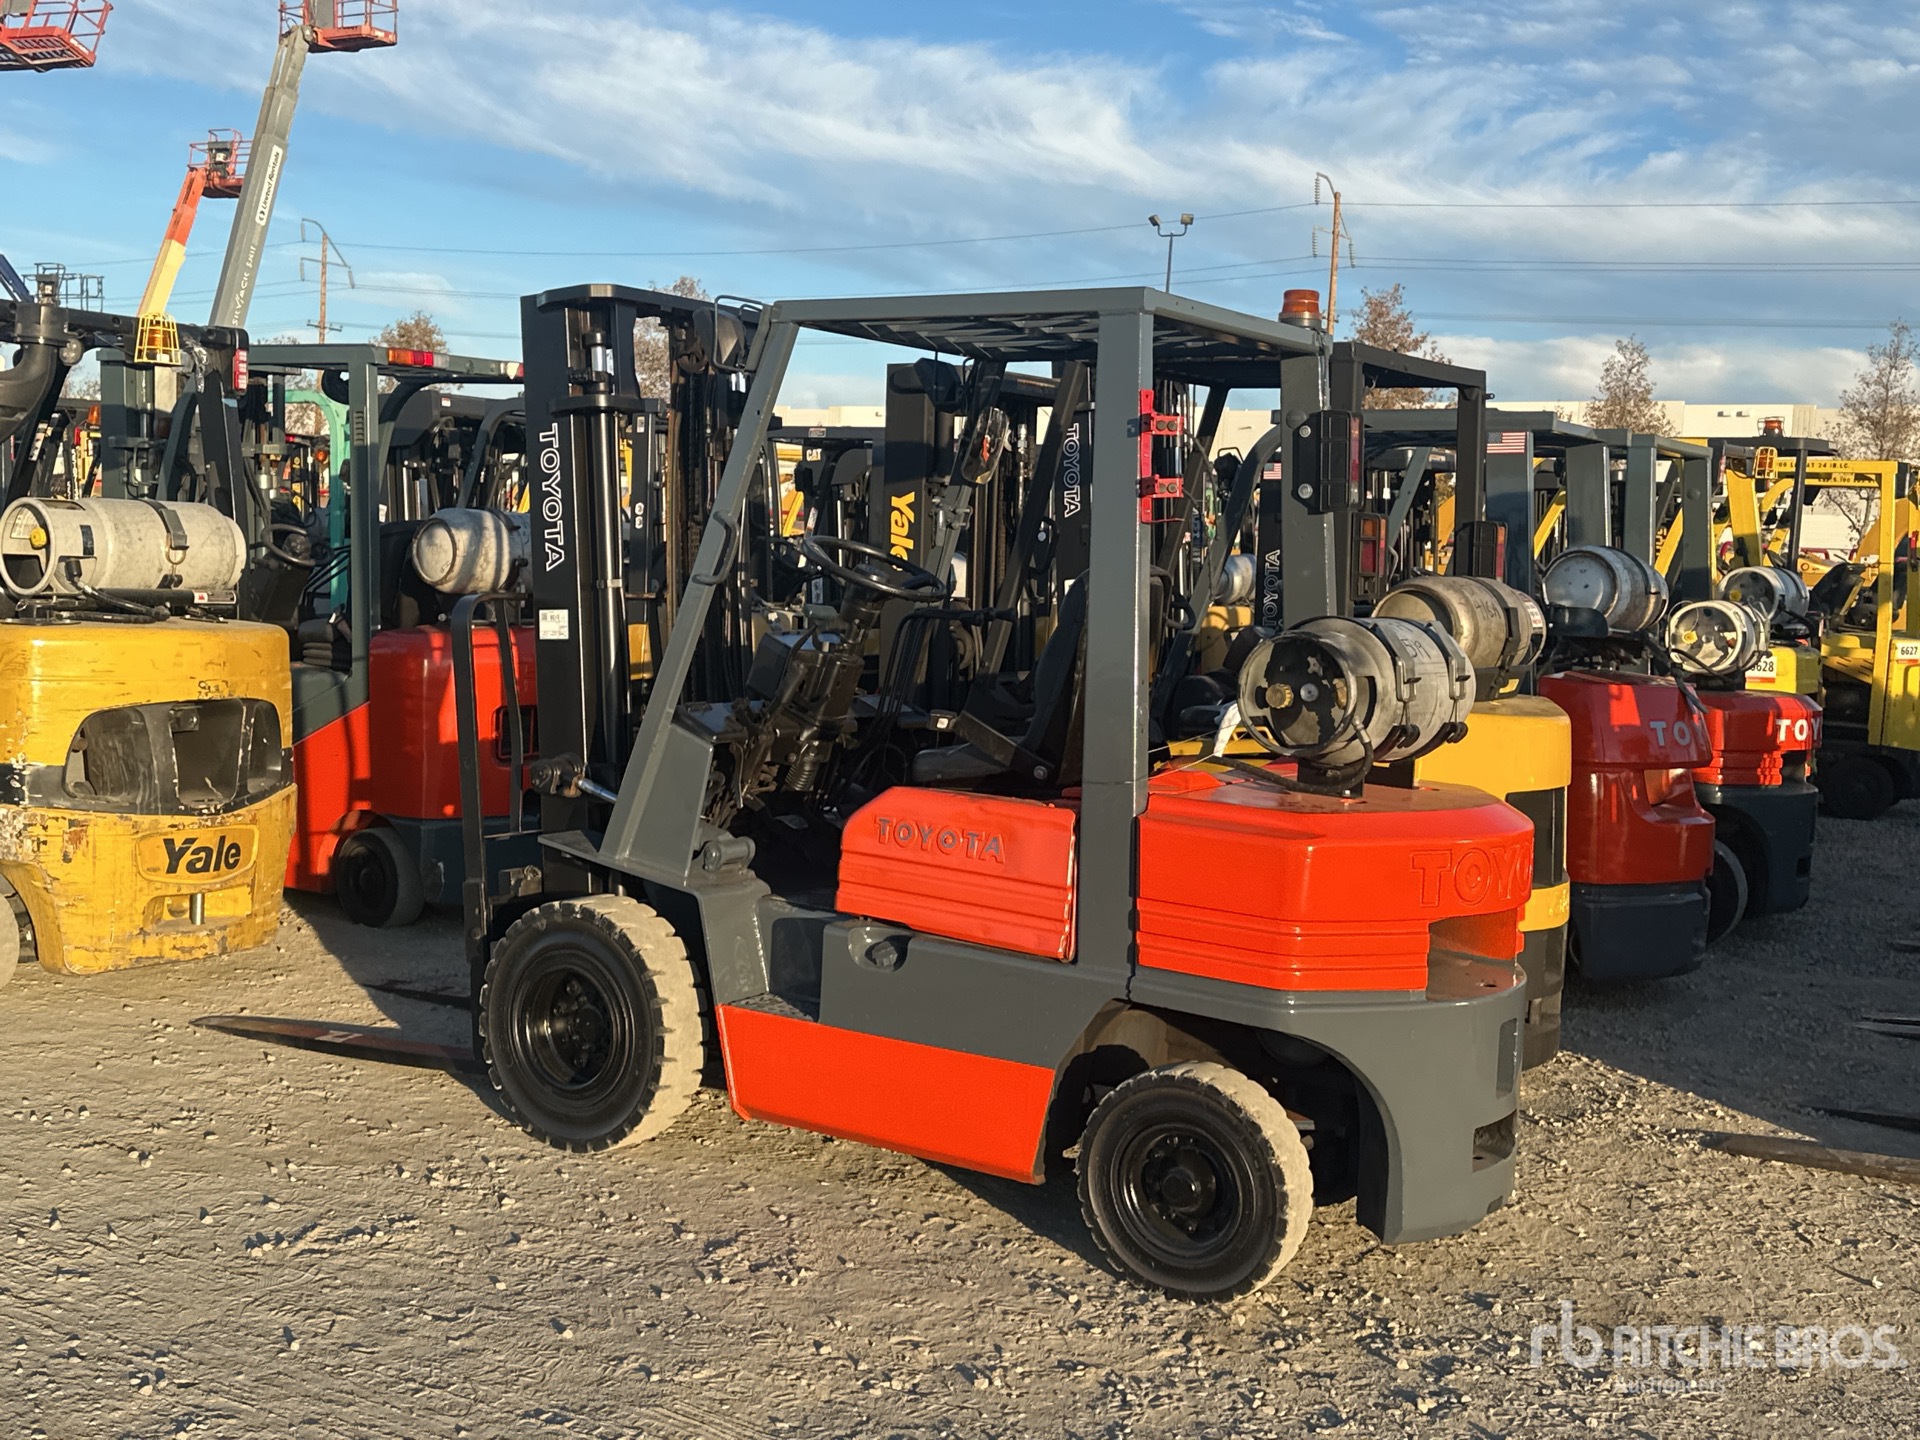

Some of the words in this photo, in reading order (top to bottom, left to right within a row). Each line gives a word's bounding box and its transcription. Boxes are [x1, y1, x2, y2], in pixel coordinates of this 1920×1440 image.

[267, 151, 281, 182] Rentals
[261, 182, 274, 211] United
[806, 448, 823, 462] CAT
[1063, 422, 1082, 519] TOYOTA
[538, 422, 569, 572] TOYOTA
[1262, 548, 1281, 629] TOYOTA
[1900, 645, 1919, 656] 6627
[162, 834, 242, 875] Yale
[874, 813, 1006, 866] TOYOTA
